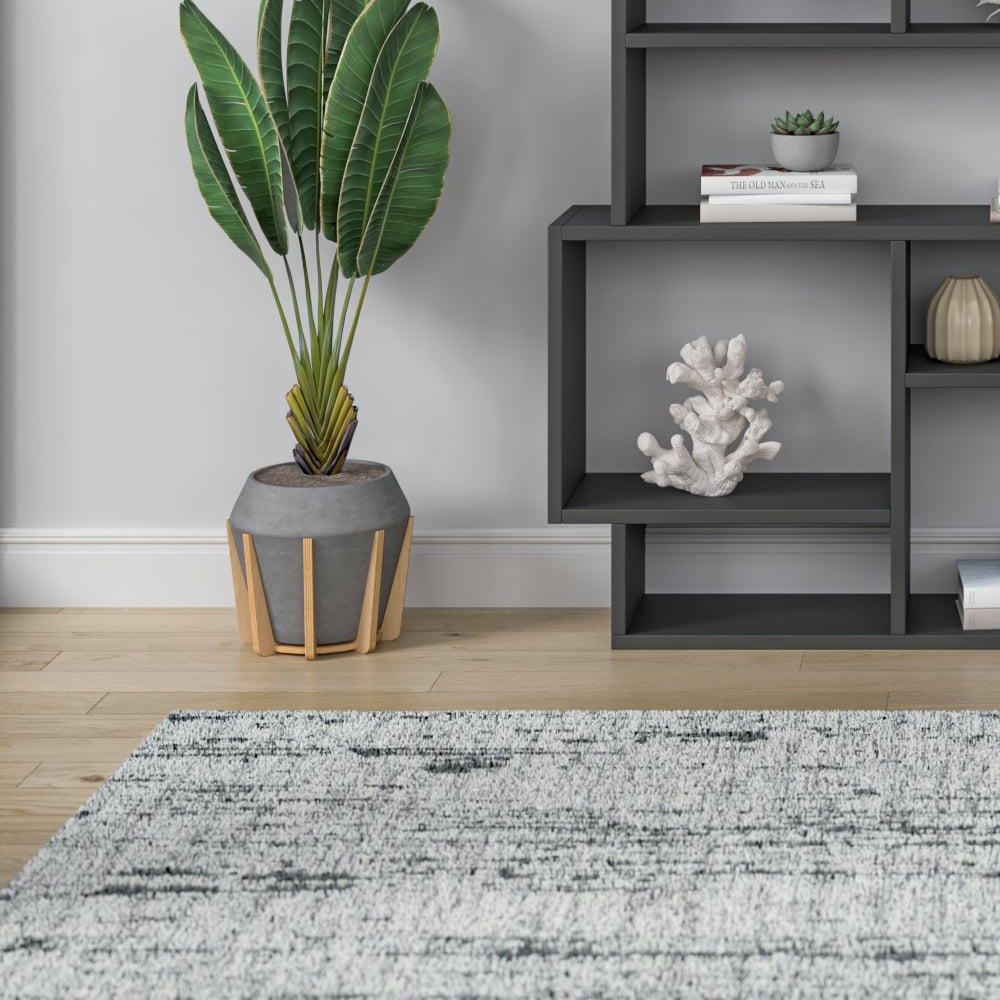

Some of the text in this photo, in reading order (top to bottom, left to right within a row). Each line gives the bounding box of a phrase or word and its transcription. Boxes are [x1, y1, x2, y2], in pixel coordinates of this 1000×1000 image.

[730, 180, 747, 190] THE
[748, 180, 767, 190] OLD
[767, 180, 786, 189] MAN
[809, 179, 825, 189] SEA
